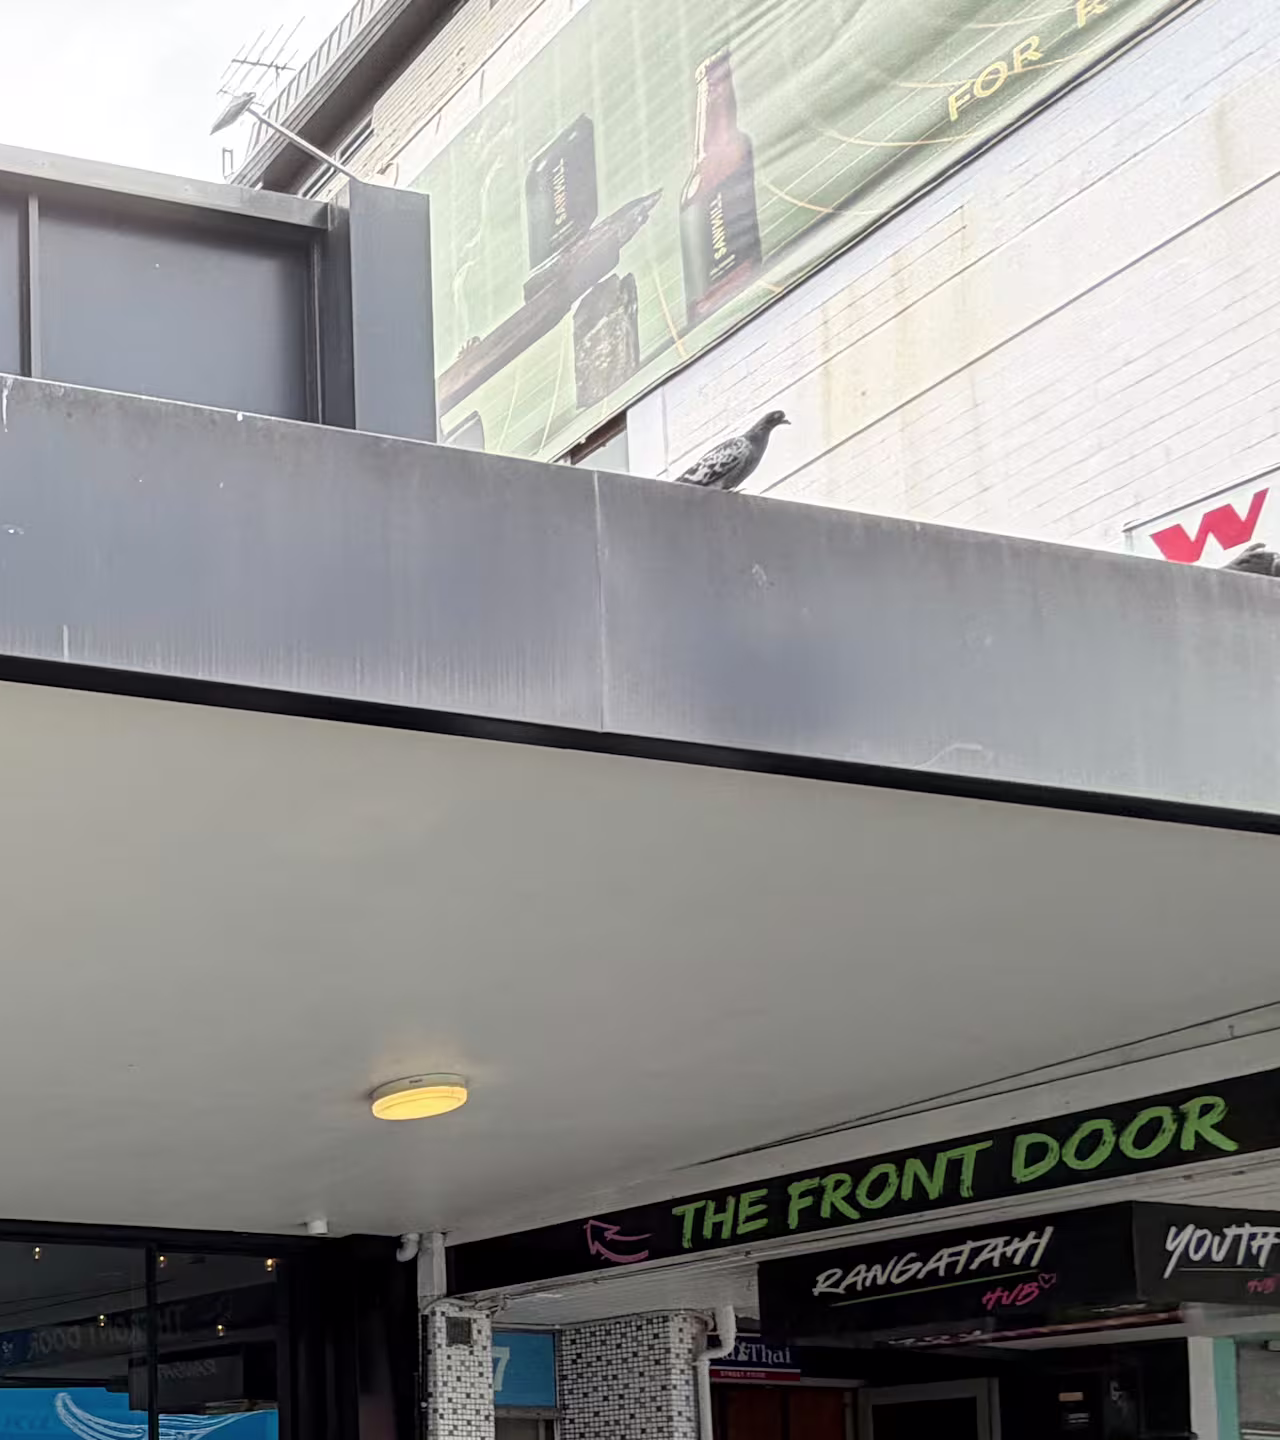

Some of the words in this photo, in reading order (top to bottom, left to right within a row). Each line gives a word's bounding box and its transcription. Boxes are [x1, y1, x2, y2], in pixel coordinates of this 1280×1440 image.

[948, 35, 1043, 121] FOR
[671, 1188, 769, 1249] THE
[787, 1139, 993, 1229] FRONT
[1012, 1095, 1238, 1183] DOOR
[812, 1226, 1055, 1296] RANGATAHI
[492, 1346, 510, 1391] 7
